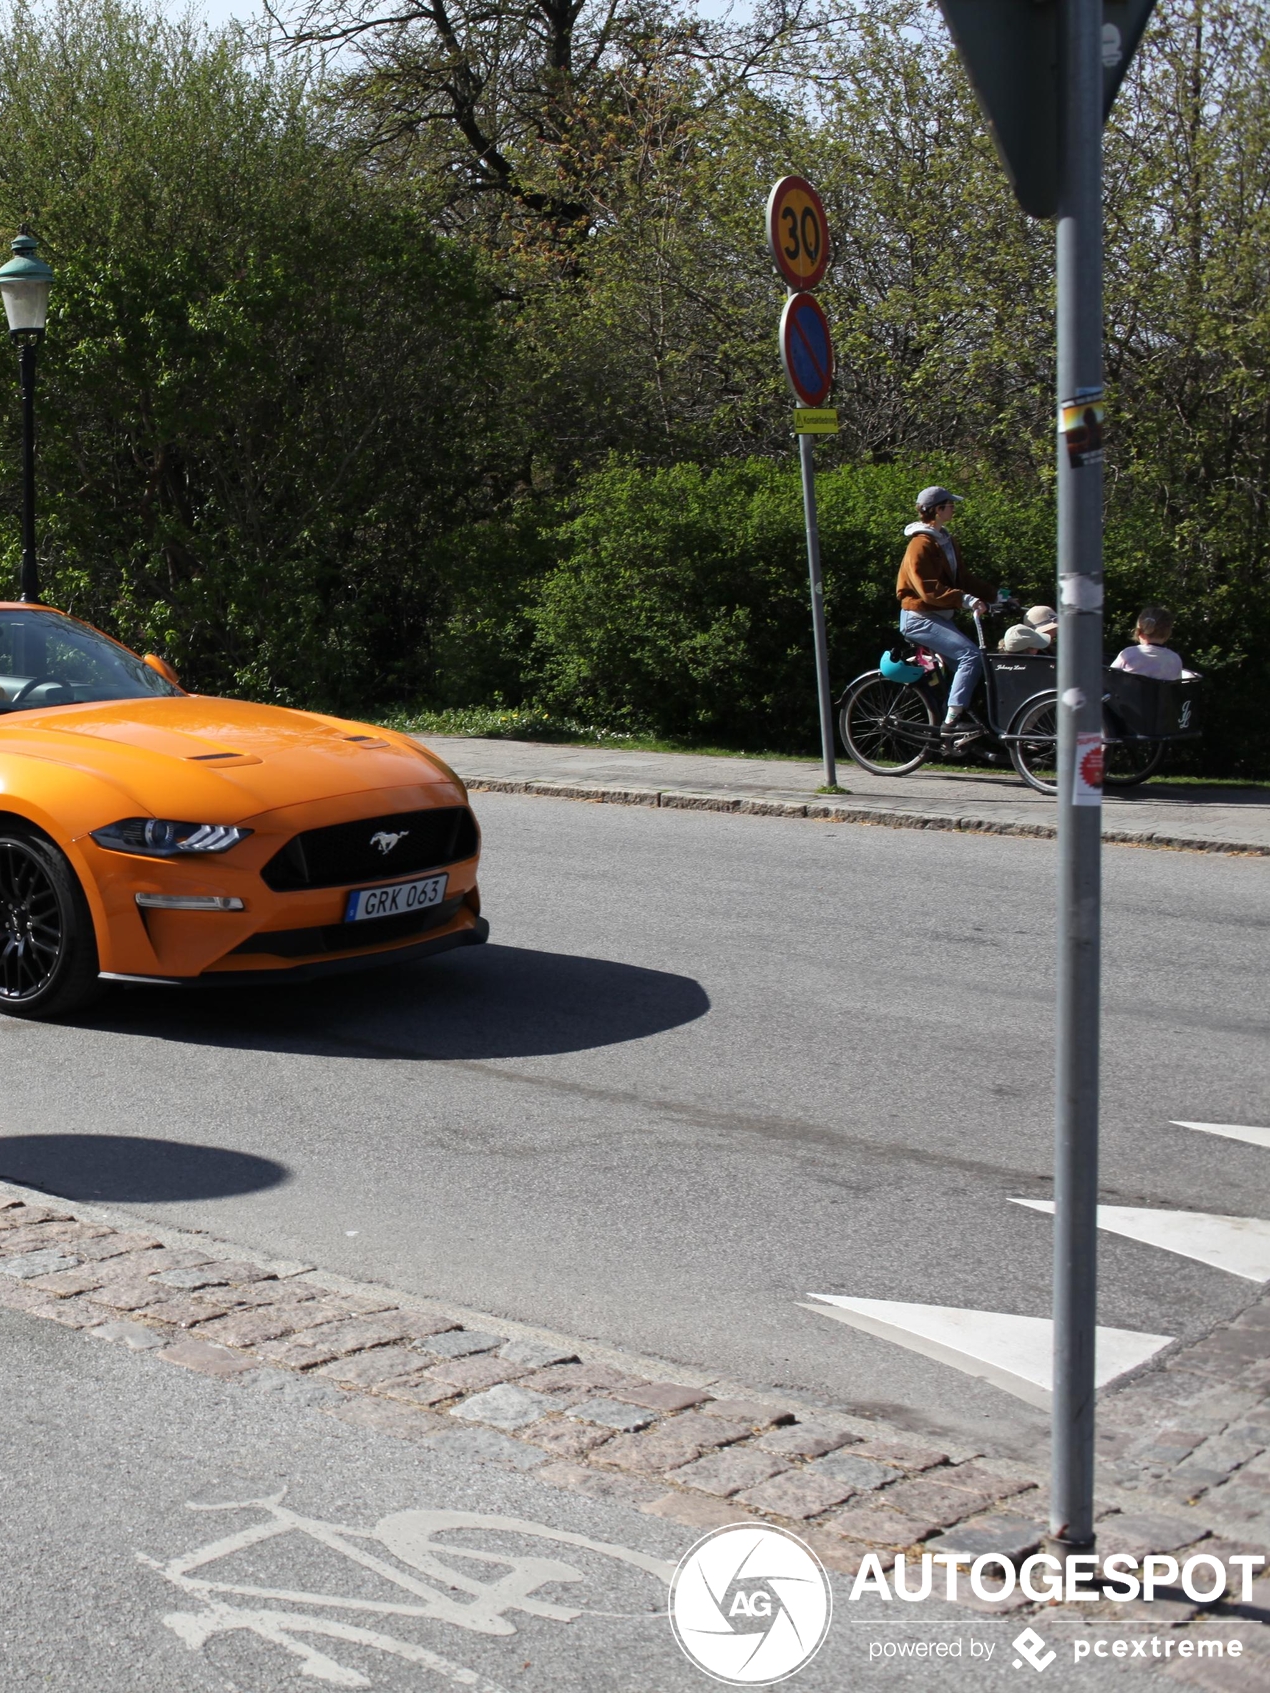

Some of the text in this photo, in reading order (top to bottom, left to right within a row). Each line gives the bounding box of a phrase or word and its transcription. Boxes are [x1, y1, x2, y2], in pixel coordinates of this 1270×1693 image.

[781, 205, 820, 261] 30
[364, 880, 440, 915] GRK 063
